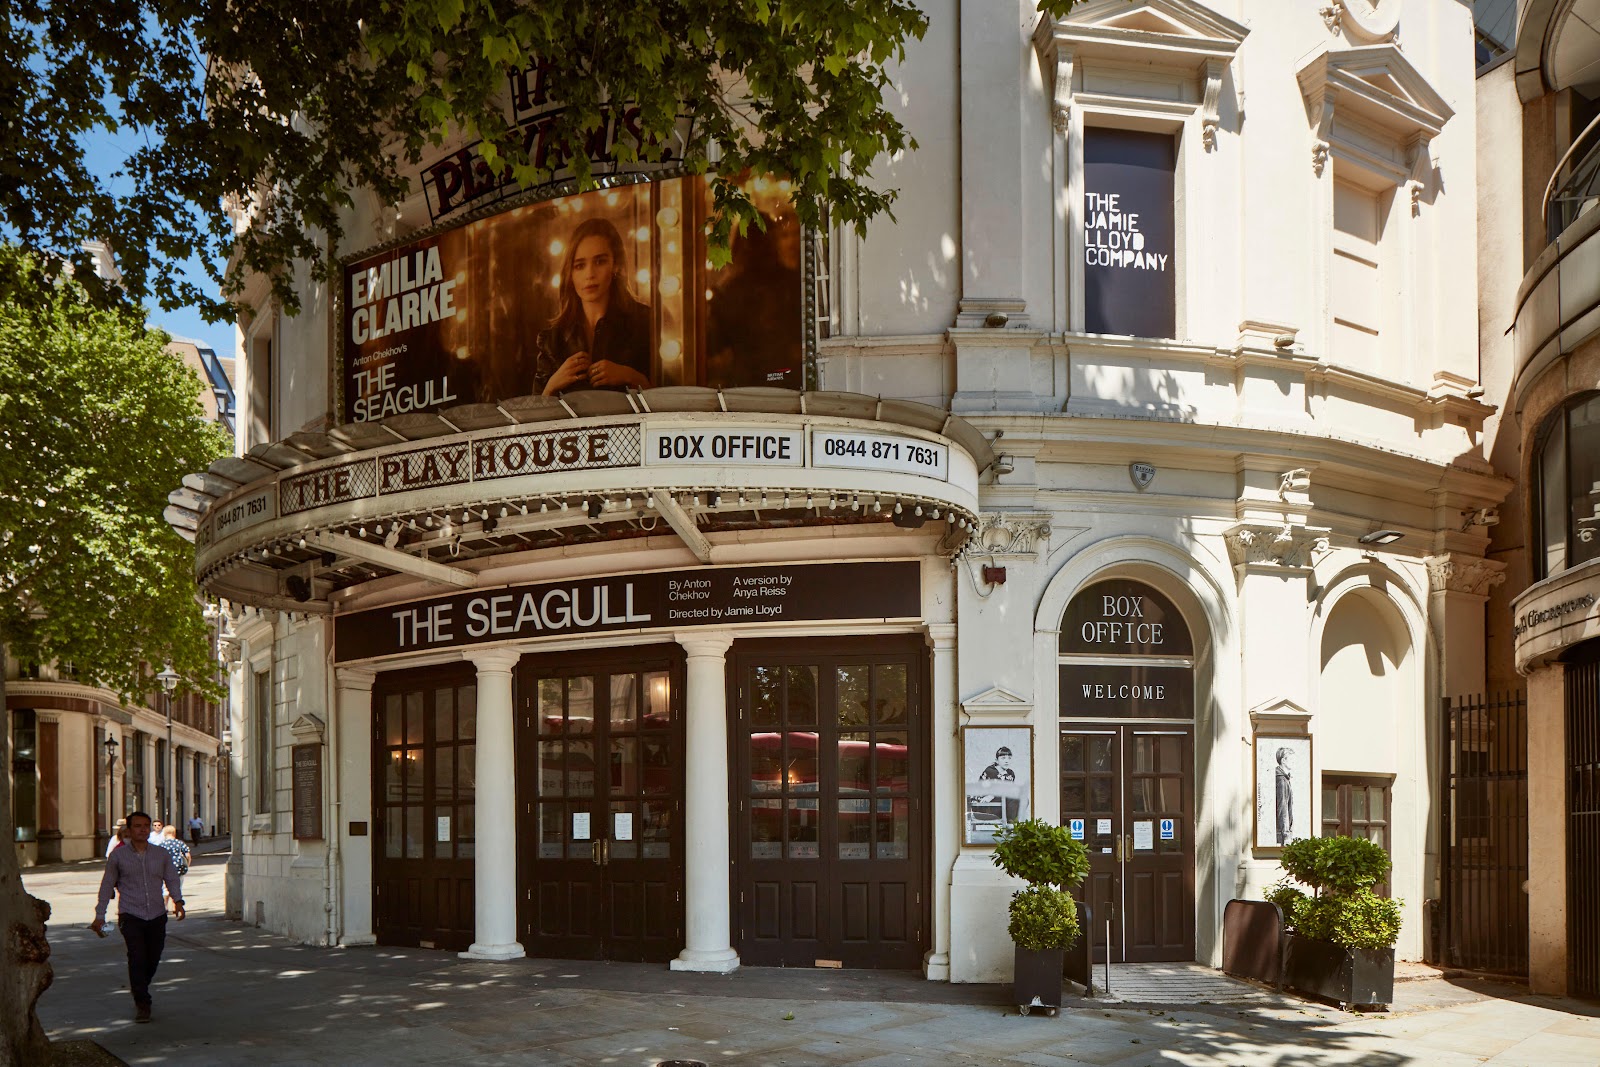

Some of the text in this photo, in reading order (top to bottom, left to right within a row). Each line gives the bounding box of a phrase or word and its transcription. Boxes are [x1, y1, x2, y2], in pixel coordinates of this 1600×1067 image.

[1084, 192, 1121, 213] THE
[1084, 211, 1139, 232] JAMIE
[1084, 229, 1145, 250] LLOYD
[1085, 247, 1168, 272] COMPANY
[351, 244, 444, 308] EMILIA
[351, 279, 457, 346] CLARKE
[352, 343, 408, 368] Anton Chekhov's
[353, 362, 397, 398] THE
[352, 375, 457, 423] SEAGULL
[658, 434, 791, 460] BOX OFFICE
[824, 437, 939, 468] 0844 871 7631
[292, 469, 352, 506] THE
[216, 495, 266, 531] 0844 871 7631
[668, 578, 712, 592] By Anton
[732, 575, 793, 587] A version by
[732, 585, 787, 599] Anya Reiss
[668, 589, 711, 601] Chekhov
[1102, 595, 1144, 618] BOX
[391, 582, 652, 648] THE SEAGULL
[668, 604, 782, 620] Directed by Jamie Lloyd
[1081, 621, 1164, 645] OFFICE
[1081, 684, 1166, 700] WELCOME
